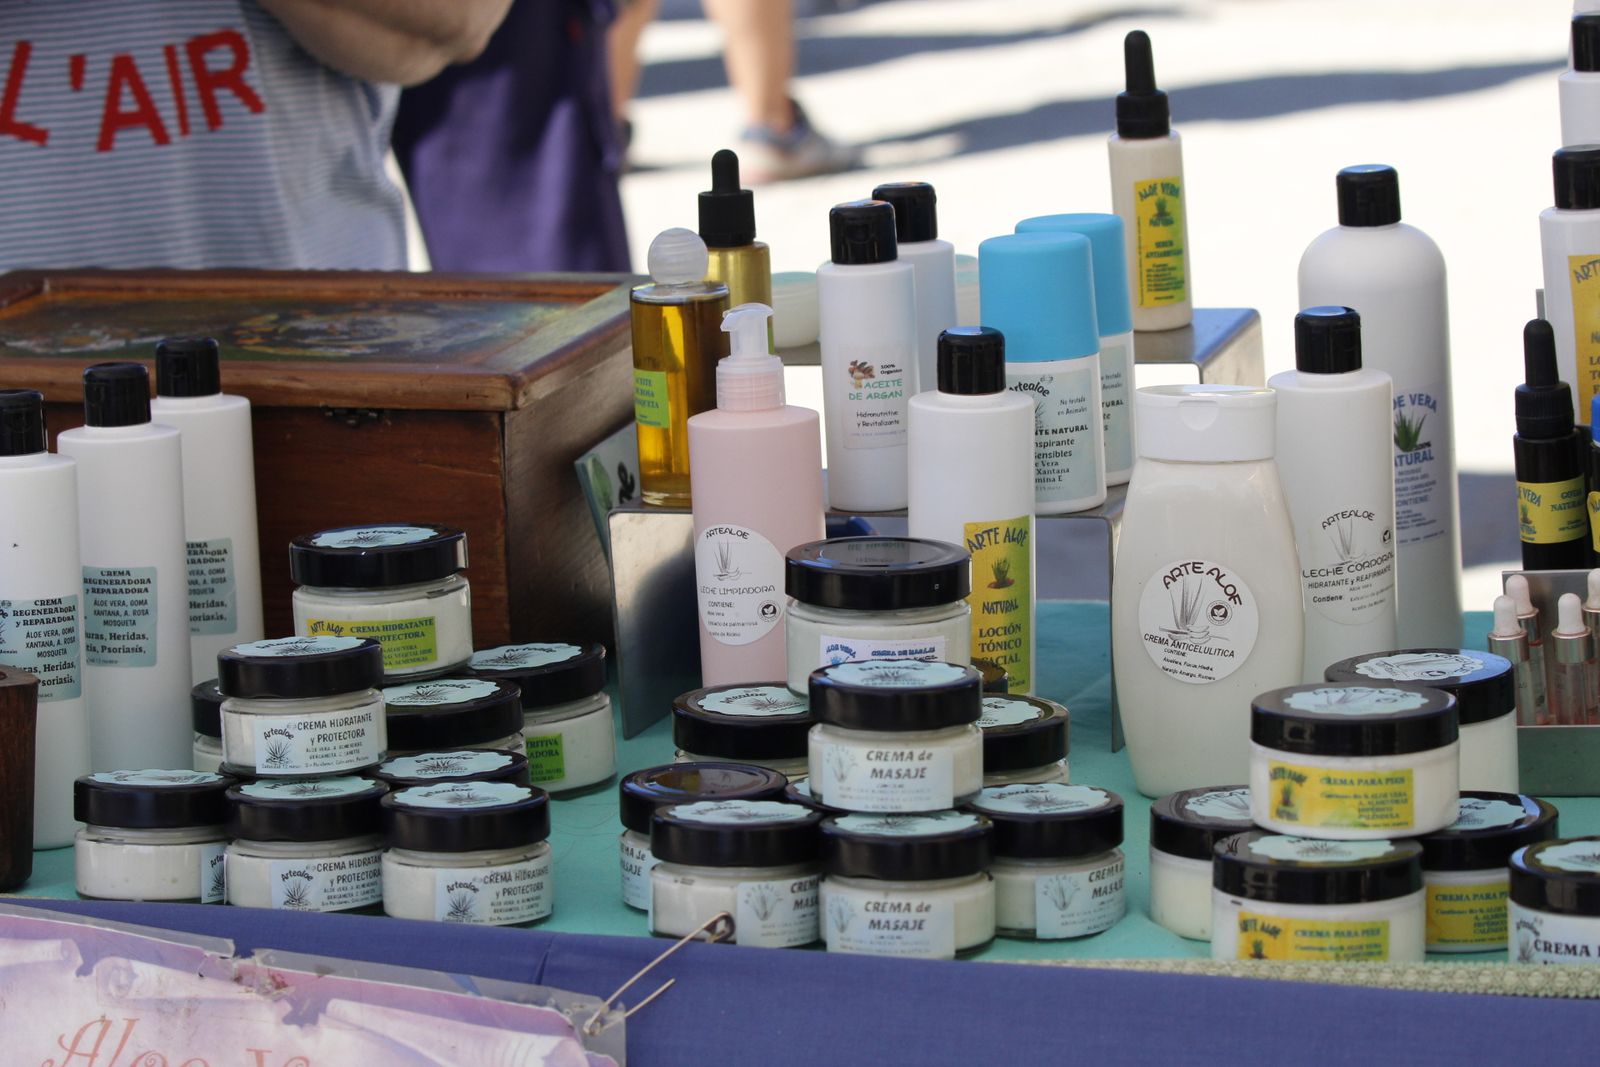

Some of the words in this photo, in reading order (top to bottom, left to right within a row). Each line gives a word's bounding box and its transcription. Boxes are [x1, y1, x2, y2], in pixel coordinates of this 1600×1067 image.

[0, 28, 266, 152] L'AIR
[864, 379, 903, 389] ACEITE
[866, 390, 903, 400] ARGAN
[1408, 393, 1437, 414] VERA
[1051, 424, 1089, 435] NATURAL
[1322, 509, 1375, 530] ARTEALOE
[705, 527, 750, 540] ARTEALOE
[966, 527, 1000, 553] ARTE
[1003, 527, 1028, 547] ALOE
[1302, 566, 1344, 578] LECHE
[83, 577, 152, 586] REGENERADORA
[1162, 561, 1204, 590] ARTE
[1206, 567, 1243, 606] ALOE
[1308, 578, 1349, 589] HIDRATANTE
[719, 584, 776, 595] LIMPIADORA
[34, 598, 62, 606] CREMA
[982, 598, 1019, 615] NATURAL
[12, 605, 76, 617] REGENERADORA
[16, 620, 20, 628] y
[23, 615, 75, 626] REPARADORA
[103, 619, 136, 627] MOSQUETA
[350, 623, 381, 634] CREMA
[382, 618, 435, 632] HIDRATANTE
[43, 629, 61, 638] VERA,
[109, 631, 149, 641] Heridas,
[978, 622, 1022, 638] LOCIÓN
[978, 637, 1022, 653] TÓNICO
[1143, 633, 1169, 647] CREMA
[1170, 639, 1235, 658] ANTICELULITICA
[37, 648, 68, 658] MOSQUETA
[43, 661, 76, 673] Heridas,
[297, 720, 327, 731] CREMA
[329, 712, 373, 727] HIDRATANTE
[263, 727, 295, 740] Artealoe
[310, 736, 315, 745] y
[317, 728, 366, 743] PROTECTORA
[866, 750, 914, 761] CREMA
[917, 750, 933, 760] de
[870, 767, 927, 779] MASAJE
[316, 860, 346, 872] CREMA
[281, 869, 314, 882] Artealoe
[483, 871, 512, 884] CREMA
[1088, 864, 1119, 882] CREMA
[329, 879, 334, 887] y
[446, 881, 479, 894] Artealoe
[496, 890, 500, 898] y
[502, 882, 544, 897] PROTECTORA
[864, 900, 912, 913] CREMA
[915, 902, 932, 912] de
[868, 919, 926, 931] MASAJE
[1534, 938, 1591, 957] CREMA
